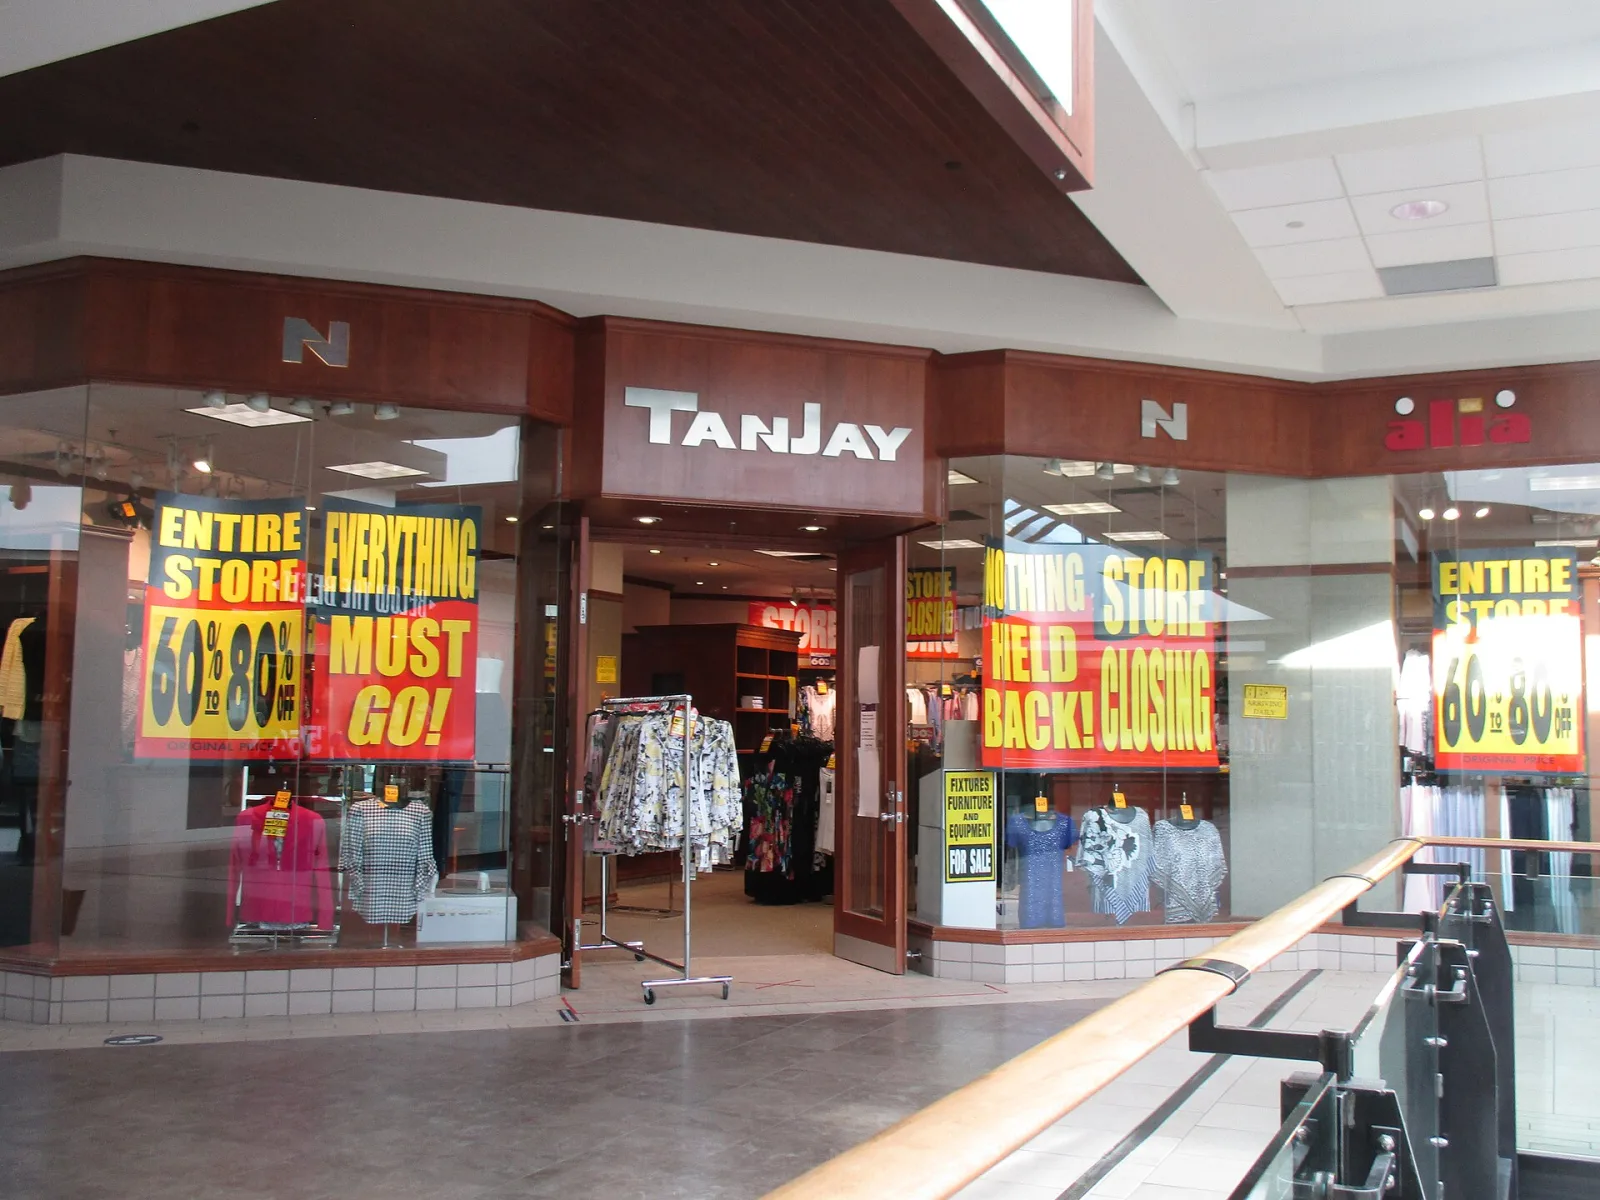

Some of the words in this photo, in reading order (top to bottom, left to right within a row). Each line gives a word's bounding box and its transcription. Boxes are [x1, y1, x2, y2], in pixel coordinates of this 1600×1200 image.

[159, 505, 301, 554] ENTIRE
[163, 553, 299, 603] STORE
[324, 510, 476, 601] EVERYTHING
[1439, 558, 1572, 595] ENTIRE
[906, 571, 952, 598] STORE
[984, 546, 1084, 613] NOTHING
[1103, 555, 1206, 638] STORE
[762, 605, 837, 649] STORE
[906, 600, 953, 637] CLOSING
[328, 615, 471, 678] MUST
[991, 622, 1078, 684] HELD
[277, 684, 296, 722] OFF
[347, 684, 452, 747] GO!
[984, 687, 1095, 750] BACK!
[1100, 645, 1213, 753] CLOSING
[948, 795, 992, 810] FURNITURE
[950, 777, 989, 792] FIXTURES
[949, 823, 991, 841] EQUIPMENT
[963, 812, 979, 821] AND
[949, 848, 967, 875] FOR
[969, 848, 992, 875] SALE
